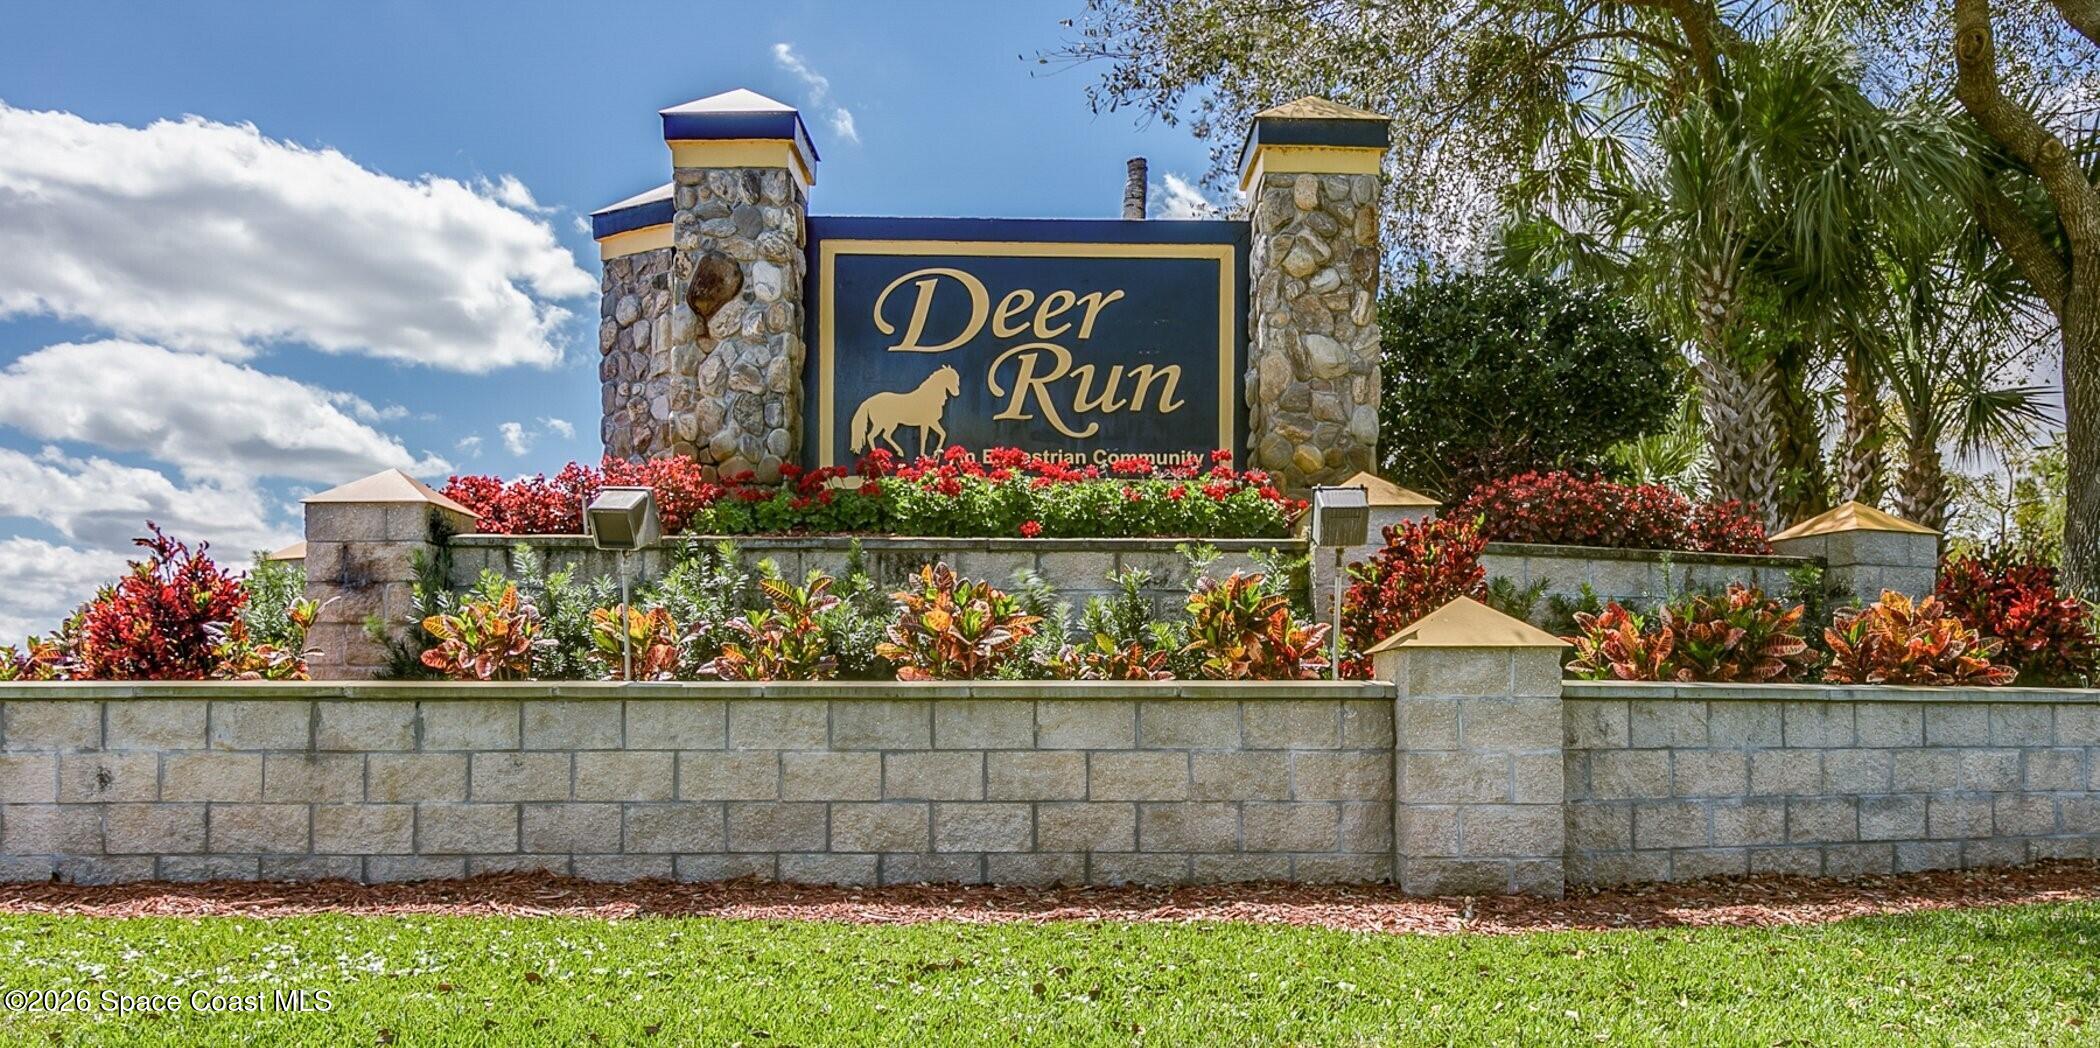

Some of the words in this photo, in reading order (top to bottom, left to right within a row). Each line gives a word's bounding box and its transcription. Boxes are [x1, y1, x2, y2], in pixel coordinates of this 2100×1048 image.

[873, 267, 1125, 353] Deer
[987, 342, 1185, 439] Run
[949, 449, 976, 464] n
[982, 448, 1087, 465] Eestrian
